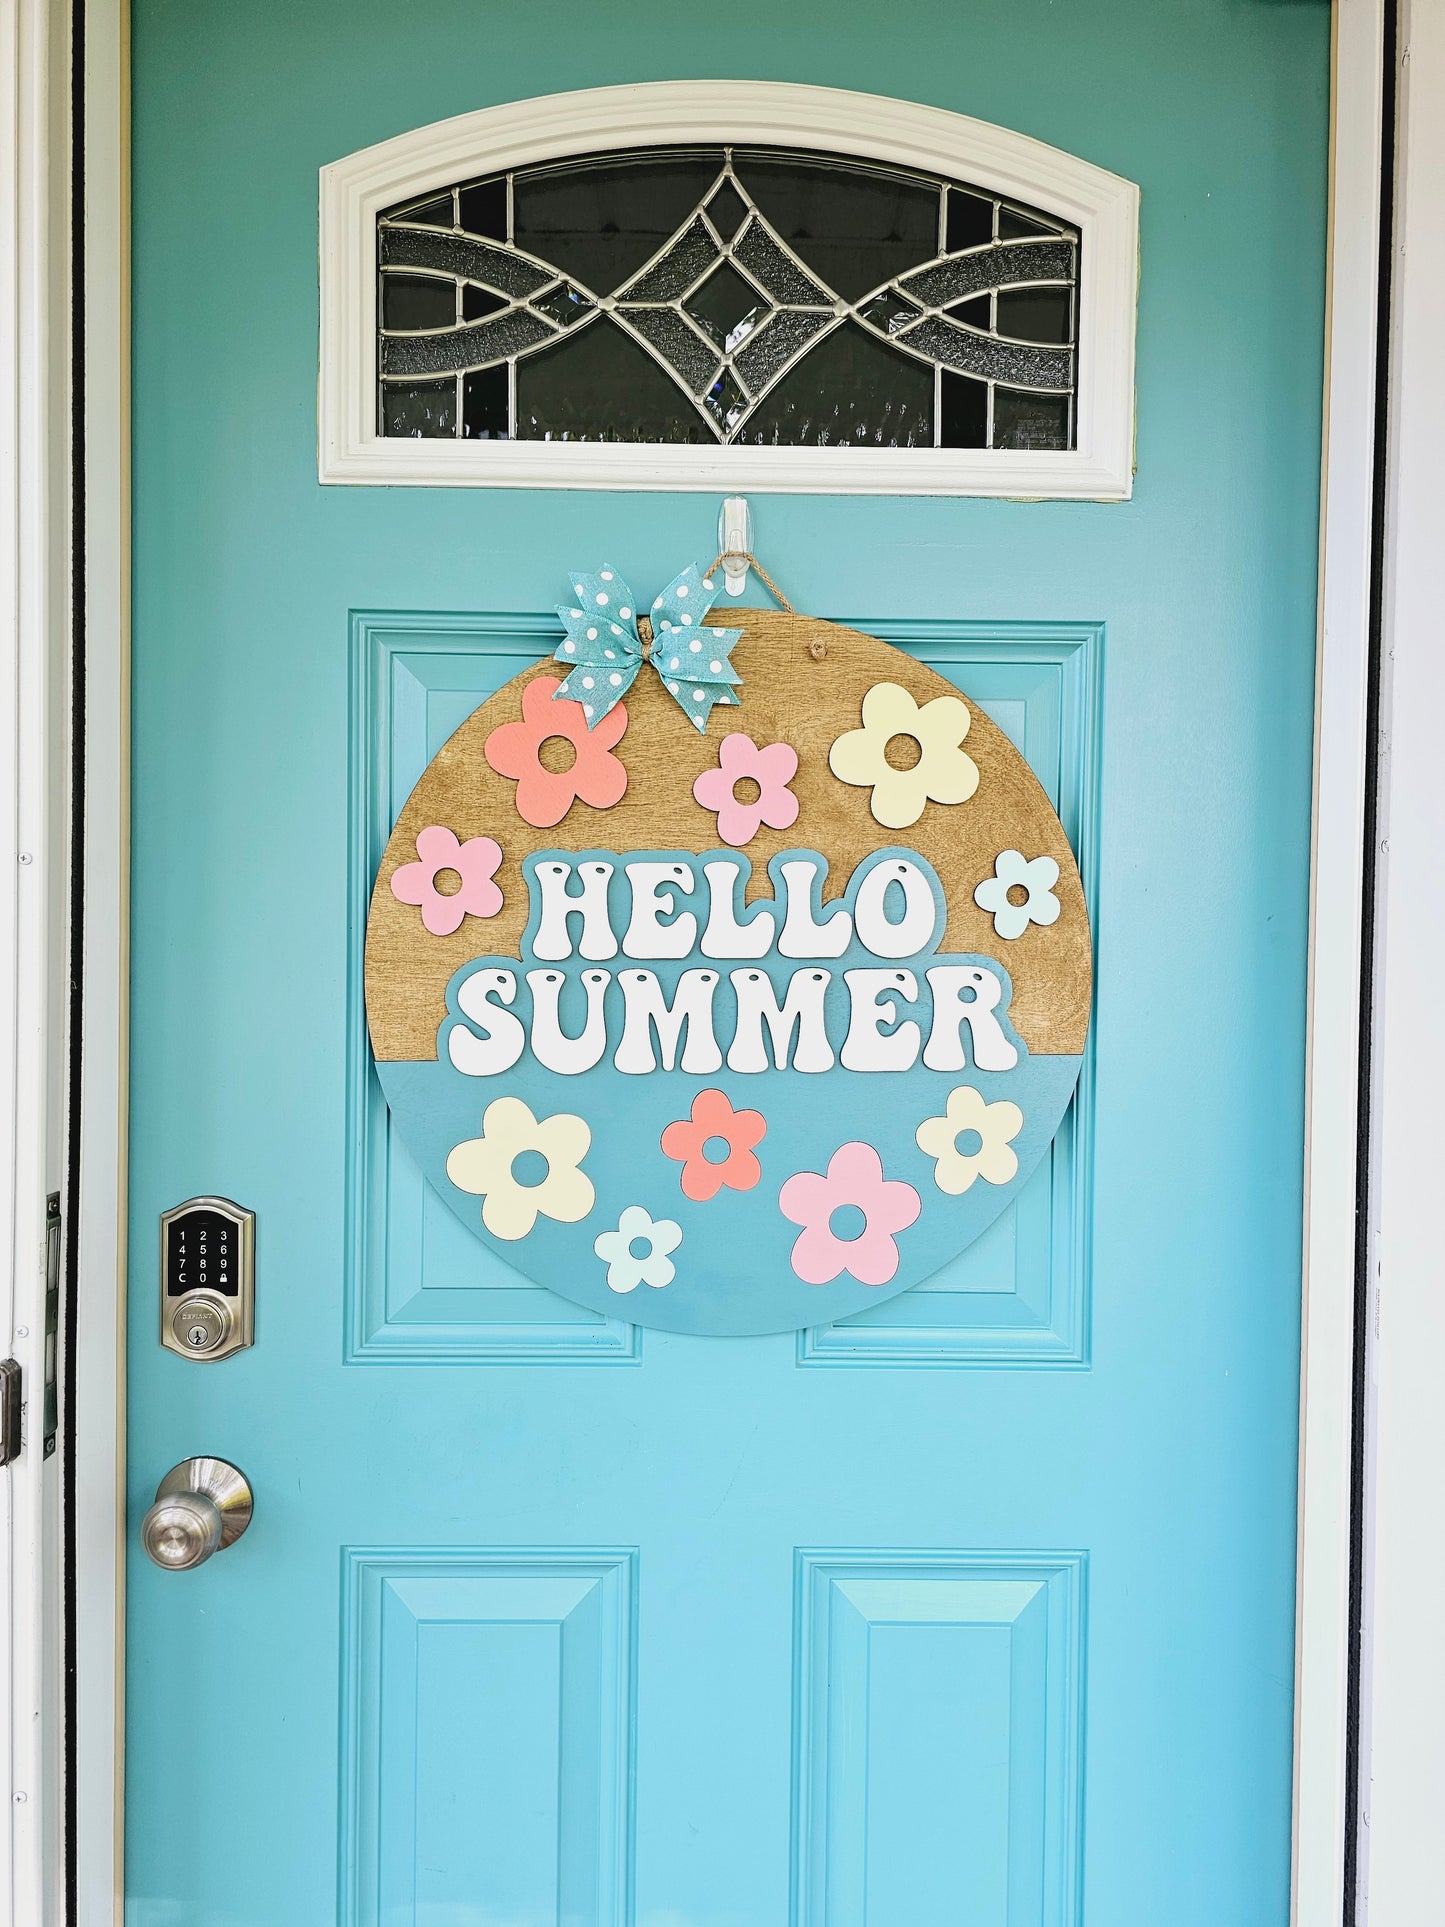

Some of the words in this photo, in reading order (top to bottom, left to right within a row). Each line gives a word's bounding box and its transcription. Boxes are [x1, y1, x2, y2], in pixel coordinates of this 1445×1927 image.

[532, 860, 936, 961] HELLO
[448, 966, 1019, 1077] SUMMER
[180, 1231, 185, 1241] 1
[200, 1231, 206, 1241] 2
[220, 1231, 227, 1241] 3
[179, 1245, 186, 1254] 4
[200, 1245, 206, 1254] 5
[220, 1245, 227, 1254] 6
[179, 1259, 186, 1268] 7
[200, 1259, 206, 1268] 8
[220, 1259, 227, 1268] 9
[179, 1273, 186, 1283] C
[200, 1273, 206, 1283] 0
